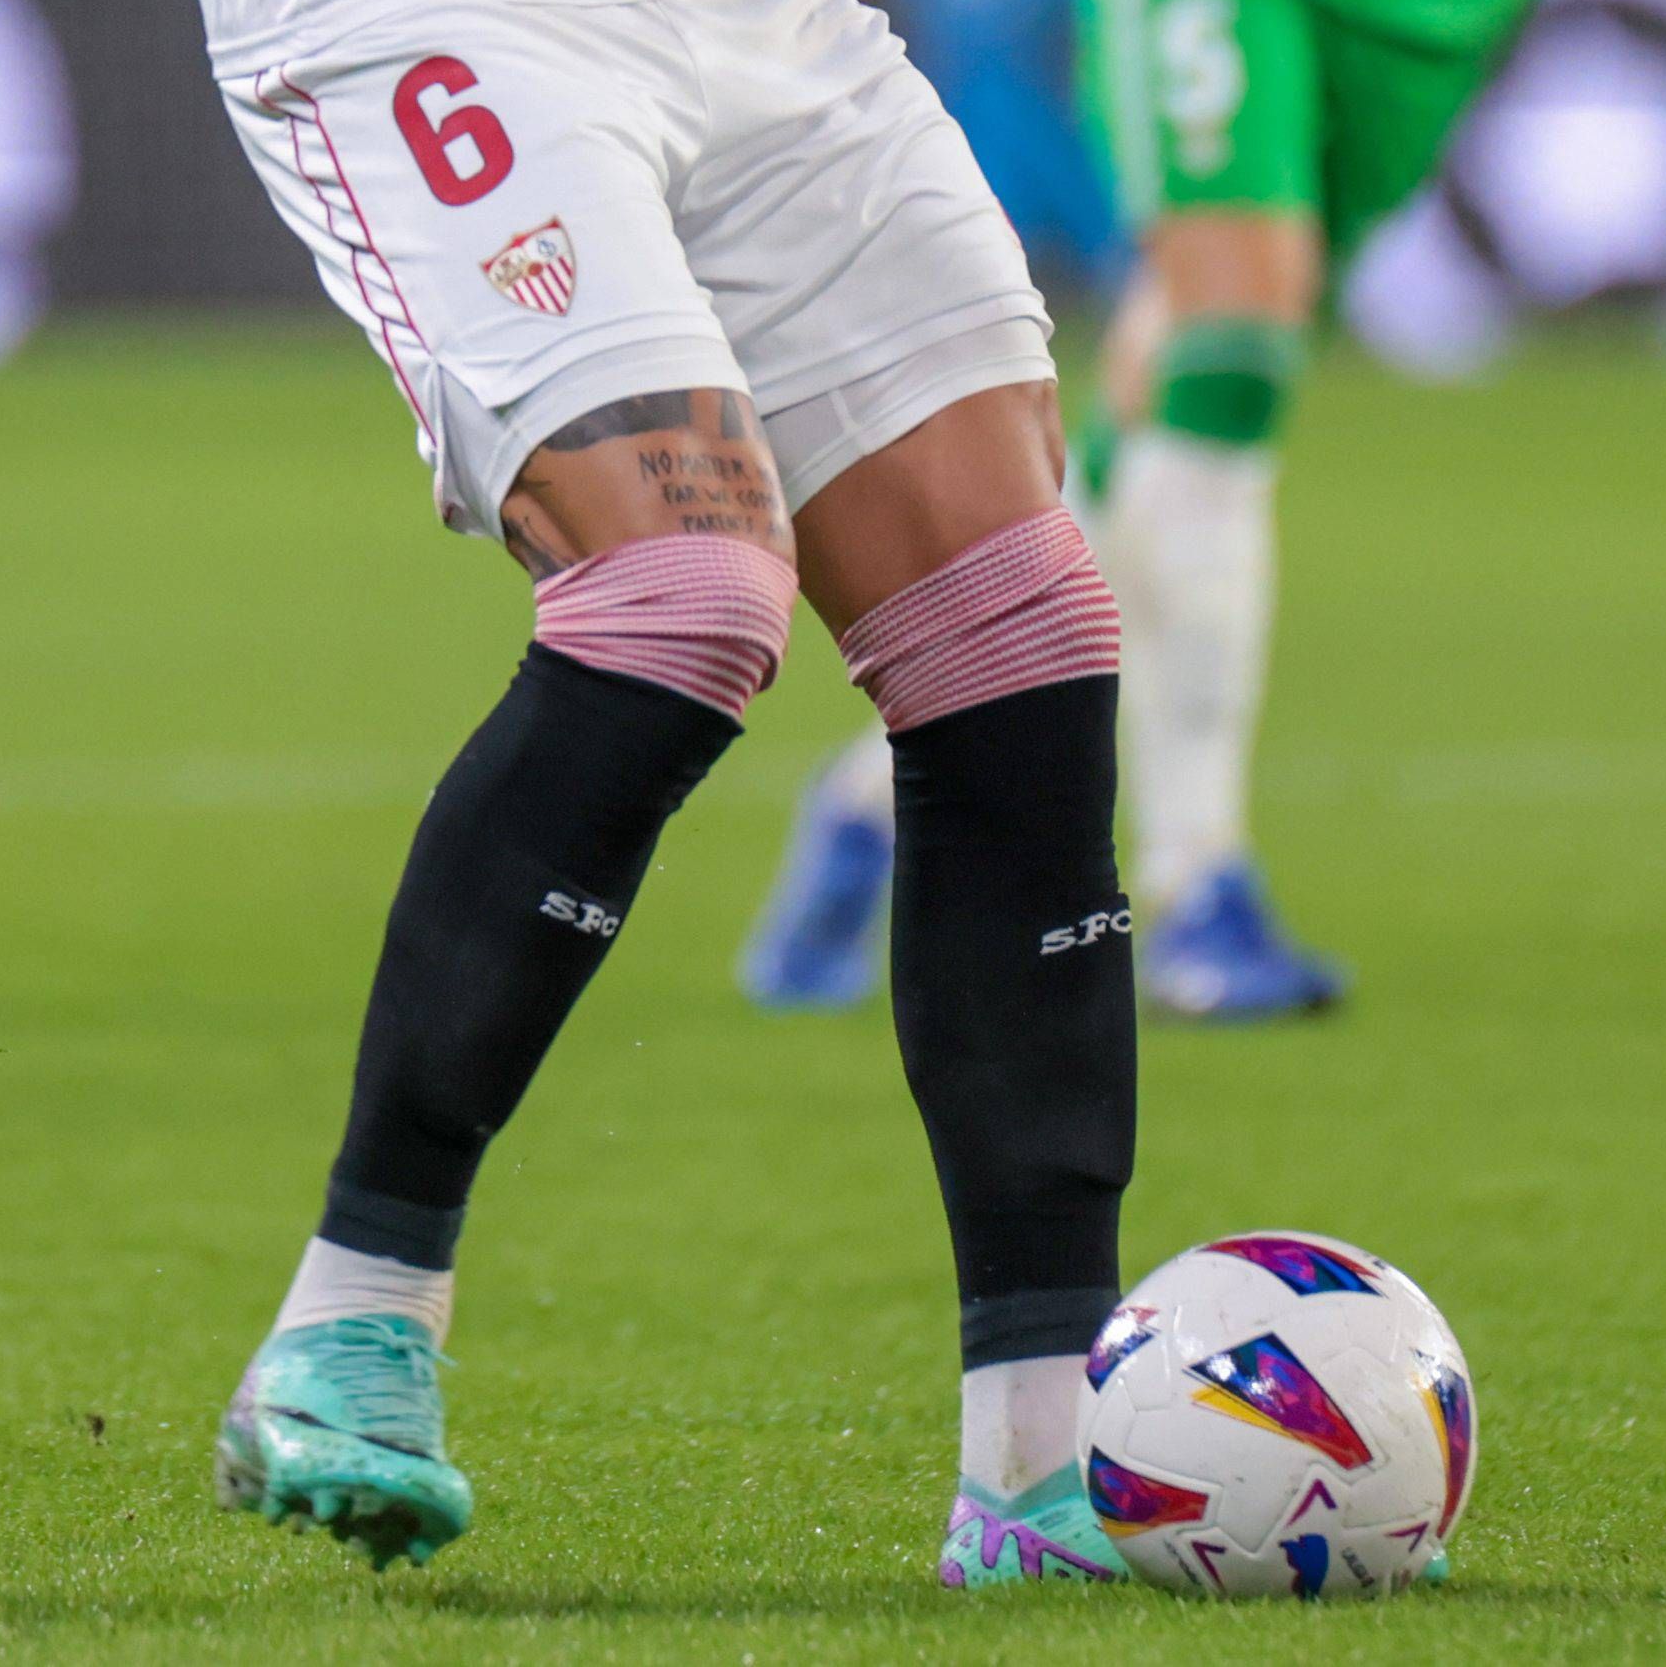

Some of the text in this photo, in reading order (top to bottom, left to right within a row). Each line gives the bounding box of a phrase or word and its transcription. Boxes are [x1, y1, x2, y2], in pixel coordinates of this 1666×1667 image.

[393, 54, 514, 207] 6
[539, 892, 621, 938] SFC
[1039, 909, 1132, 955] SFC
